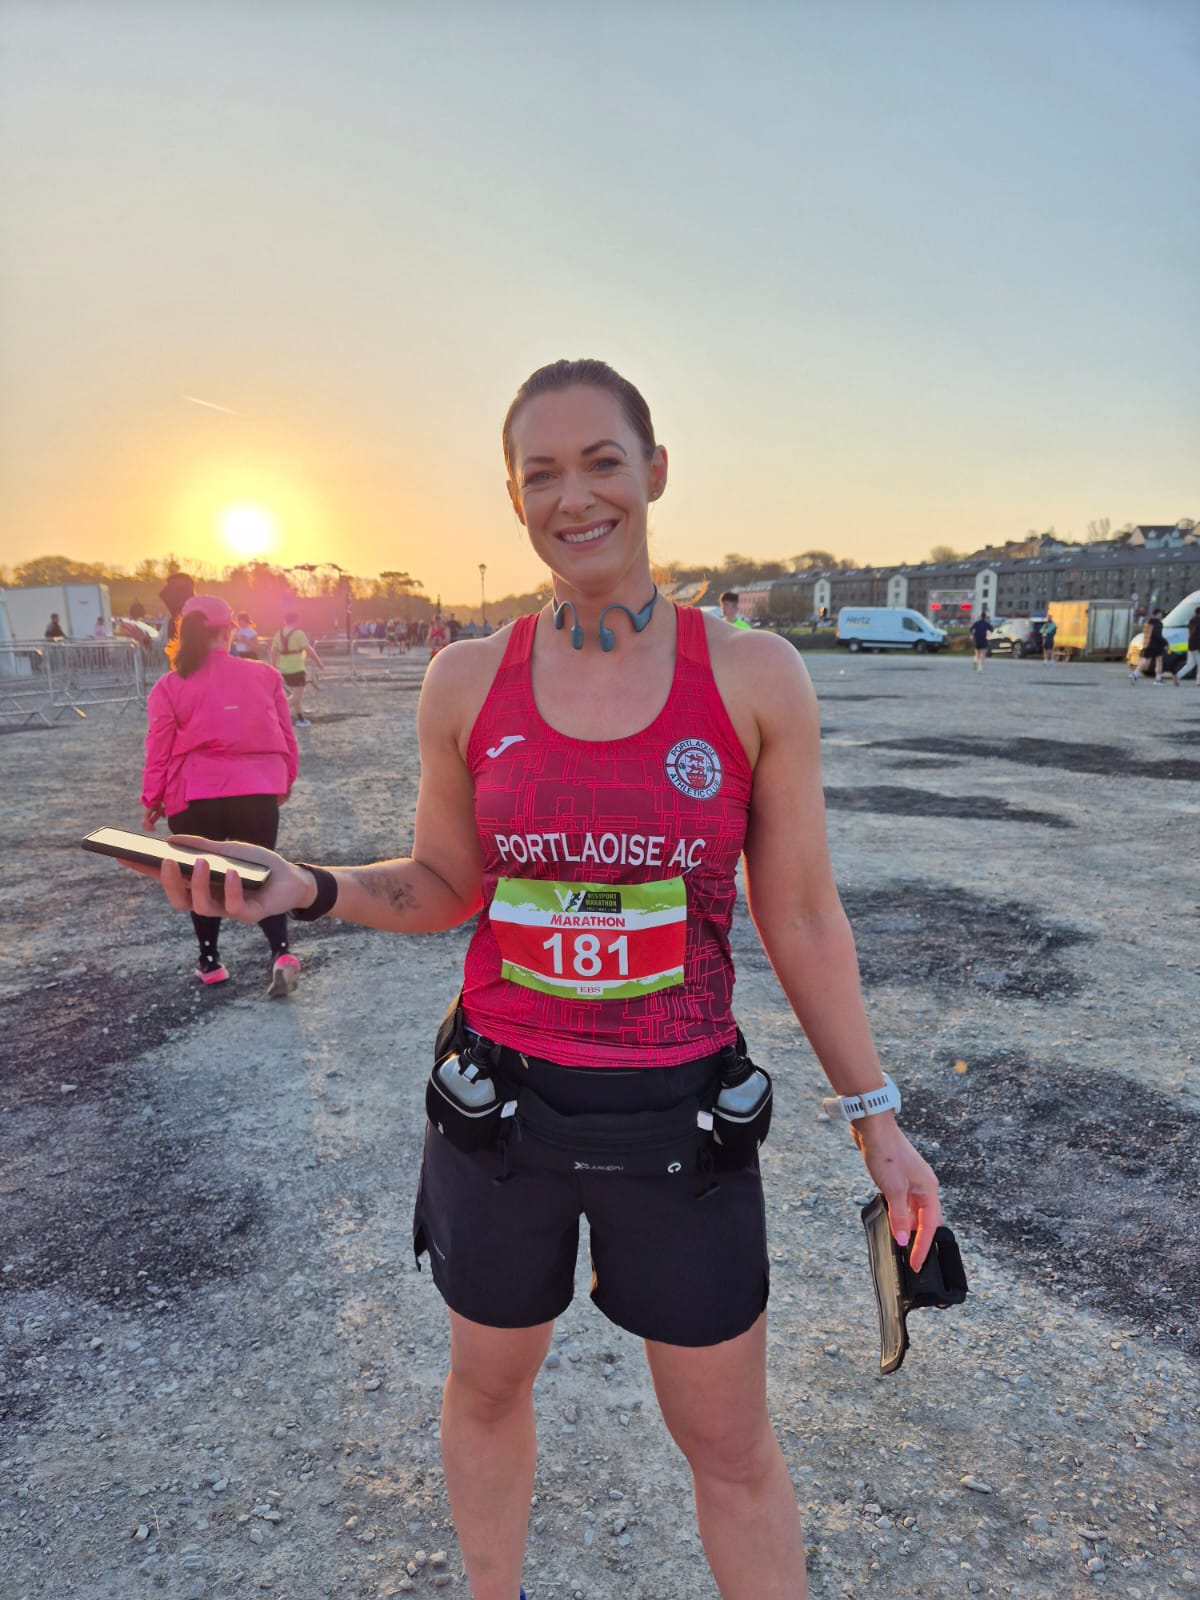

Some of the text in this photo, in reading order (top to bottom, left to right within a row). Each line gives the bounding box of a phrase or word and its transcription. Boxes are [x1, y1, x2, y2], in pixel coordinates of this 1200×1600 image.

[495, 832, 705, 867] PORTLAOISE AC
[550, 914, 625, 927] MARATHON
[543, 933, 628, 977] 181
